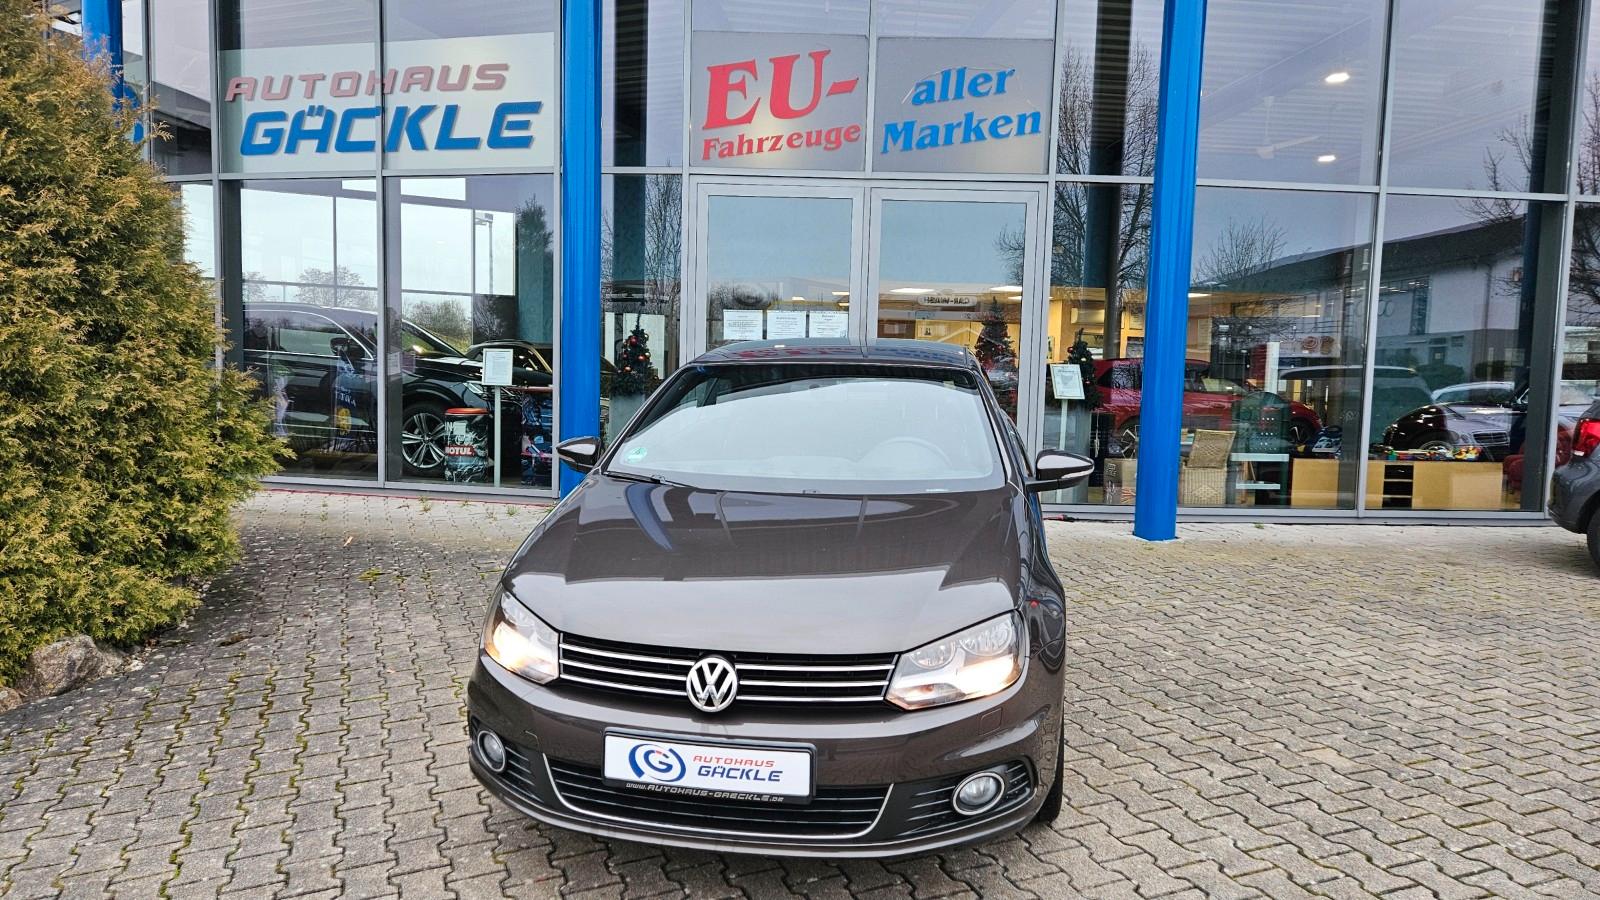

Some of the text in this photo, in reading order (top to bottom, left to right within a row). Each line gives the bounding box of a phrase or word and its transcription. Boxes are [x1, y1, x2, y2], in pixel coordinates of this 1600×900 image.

[225, 63, 509, 101] AUTOHAUS
[702, 49, 859, 130] EU-
[911, 66, 1015, 106] aller
[240, 101, 542, 155] GÄCKLE
[702, 123, 861, 160] Fahrzeuge
[880, 110, 1042, 154] Marken
[693, 755, 775, 768] AUTOHAUS
[697, 765, 783, 782] GÄCKLE
